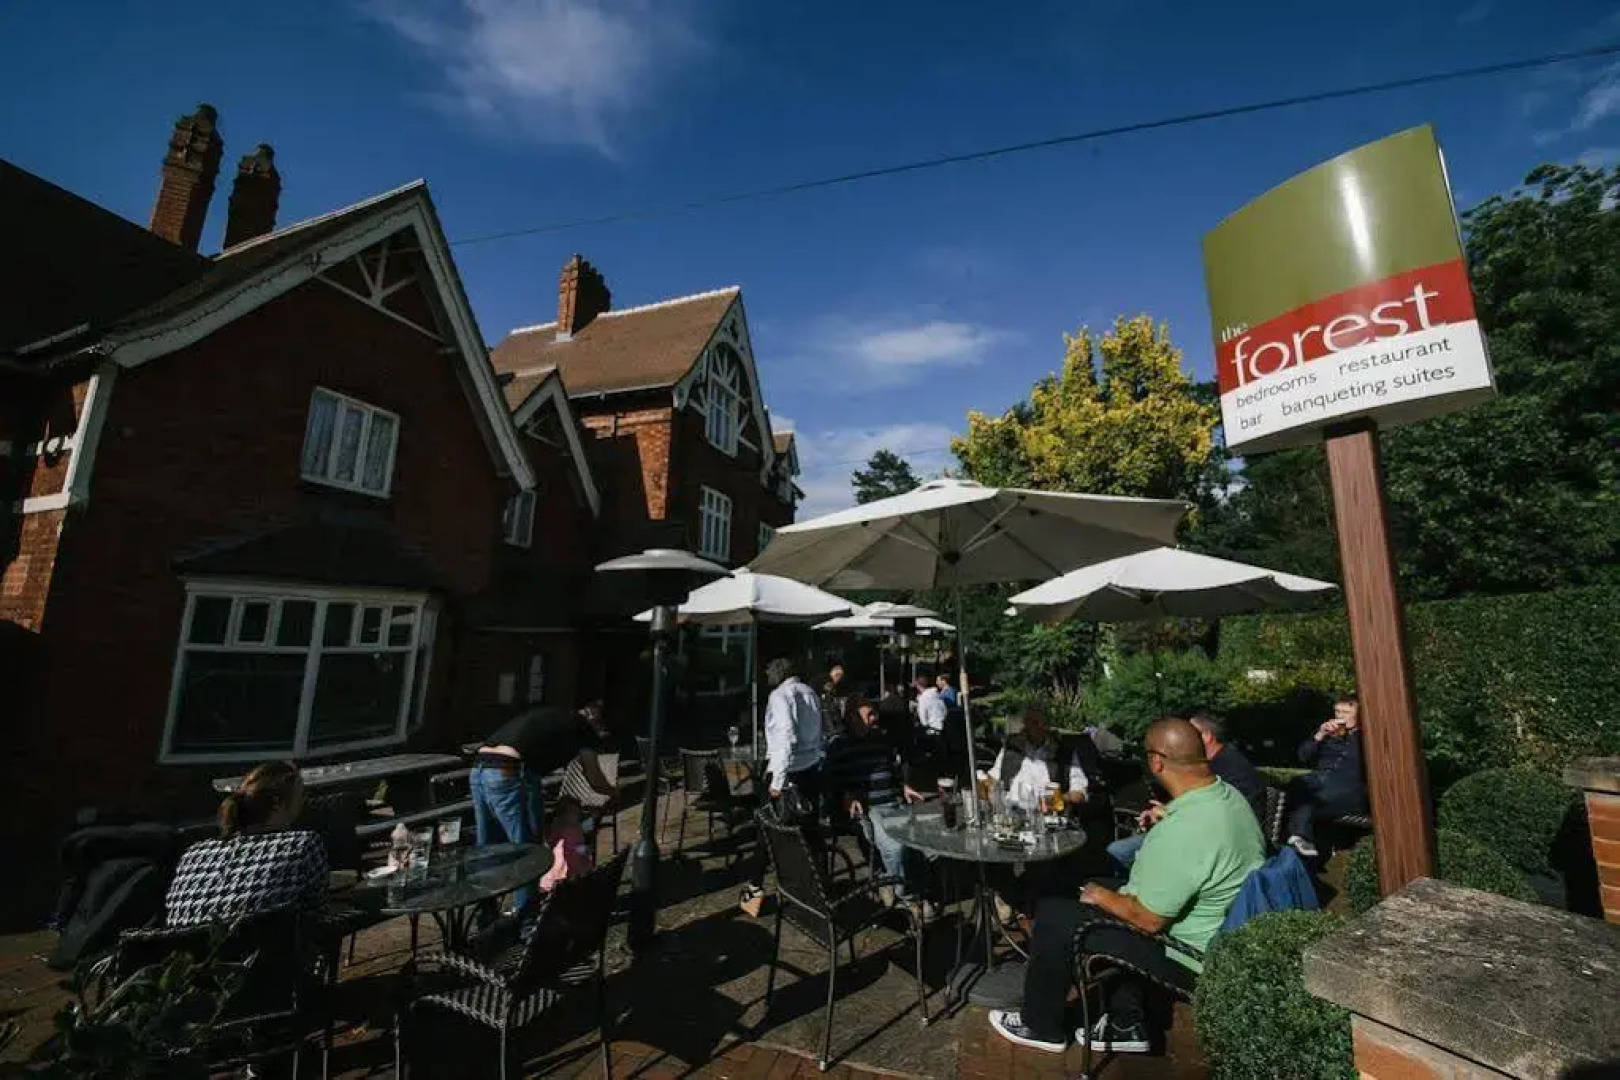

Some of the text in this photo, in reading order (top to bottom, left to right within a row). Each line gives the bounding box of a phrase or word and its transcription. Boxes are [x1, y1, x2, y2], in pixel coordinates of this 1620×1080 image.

[1221, 321, 1248, 342] the
[1231, 282, 1438, 388] forest
[1236, 337, 1451, 408] bedrooms restaurant
[1240, 366, 1455, 430] bar banqueting suites
